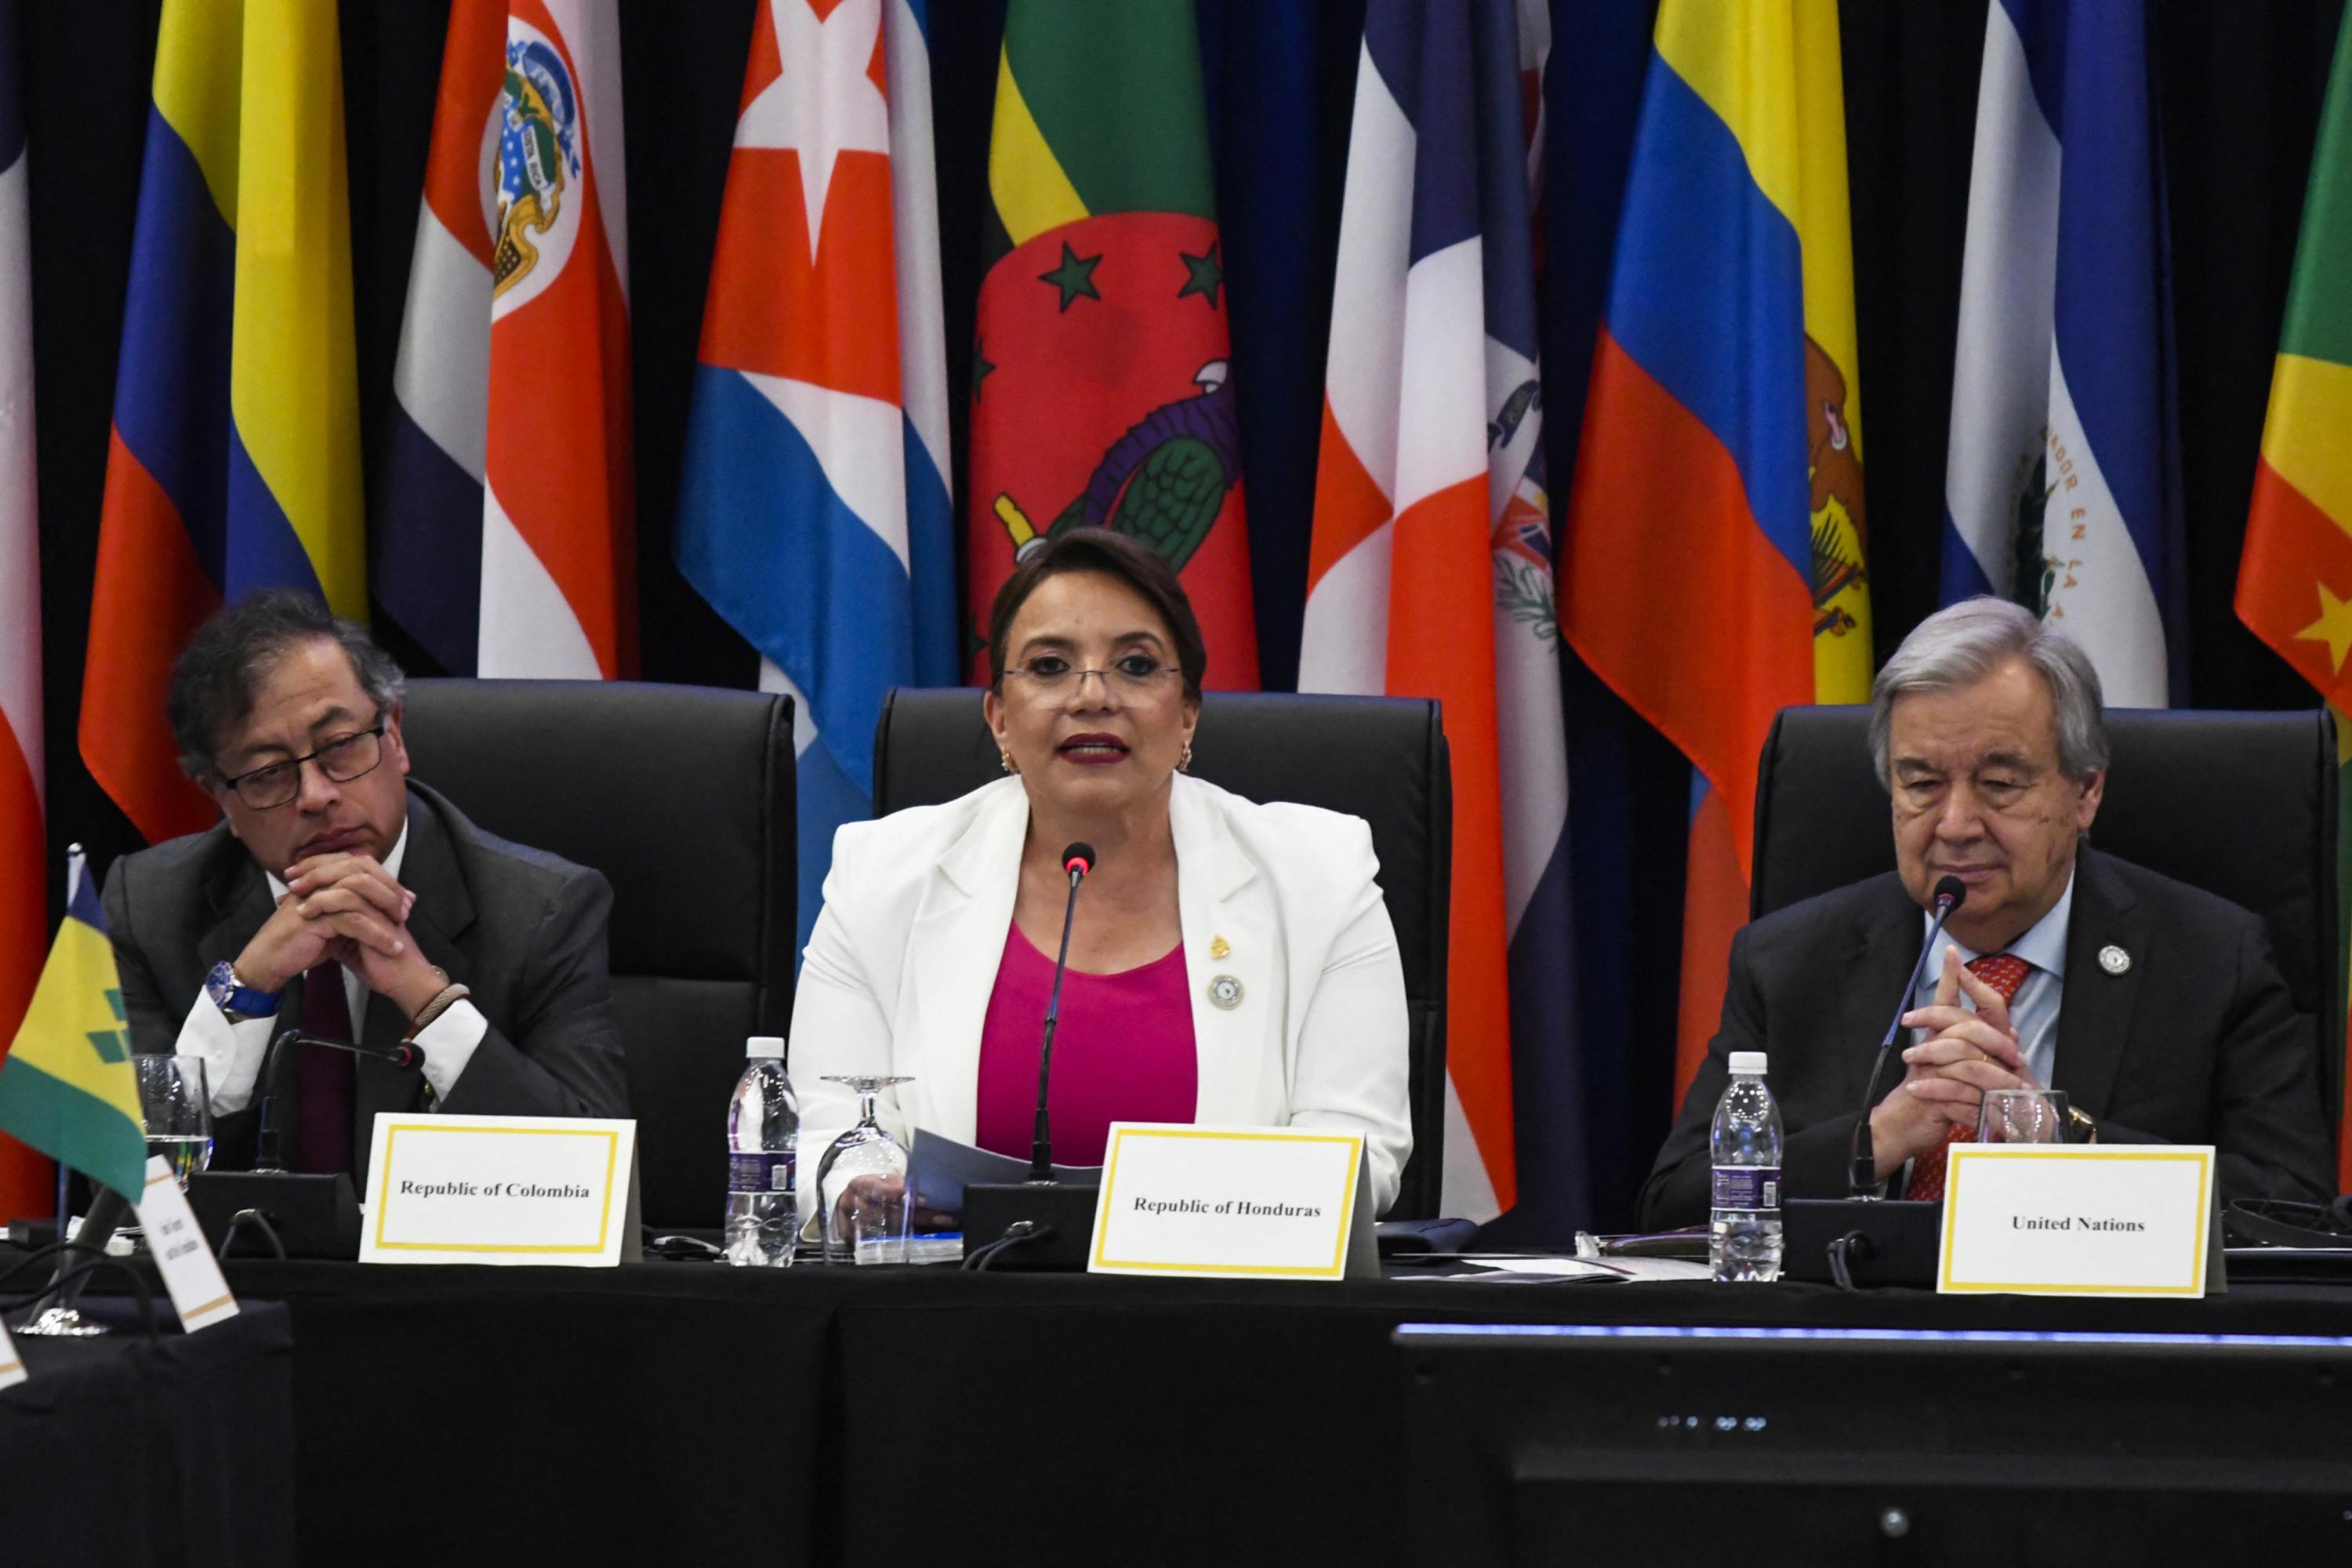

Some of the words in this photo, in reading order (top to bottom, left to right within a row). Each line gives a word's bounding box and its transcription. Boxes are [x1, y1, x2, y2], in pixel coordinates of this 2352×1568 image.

[401, 1181, 477, 1198] Republic
[484, 1184, 502, 1196] of
[506, 1184, 589, 1197] Colombia
[1134, 1198, 1209, 1214] Republic
[1215, 1202, 1232, 1214] of
[1238, 1202, 1320, 1216] Honduras
[2013, 1217, 2070, 1229] United
[2079, 1218, 2144, 1231] Nations
